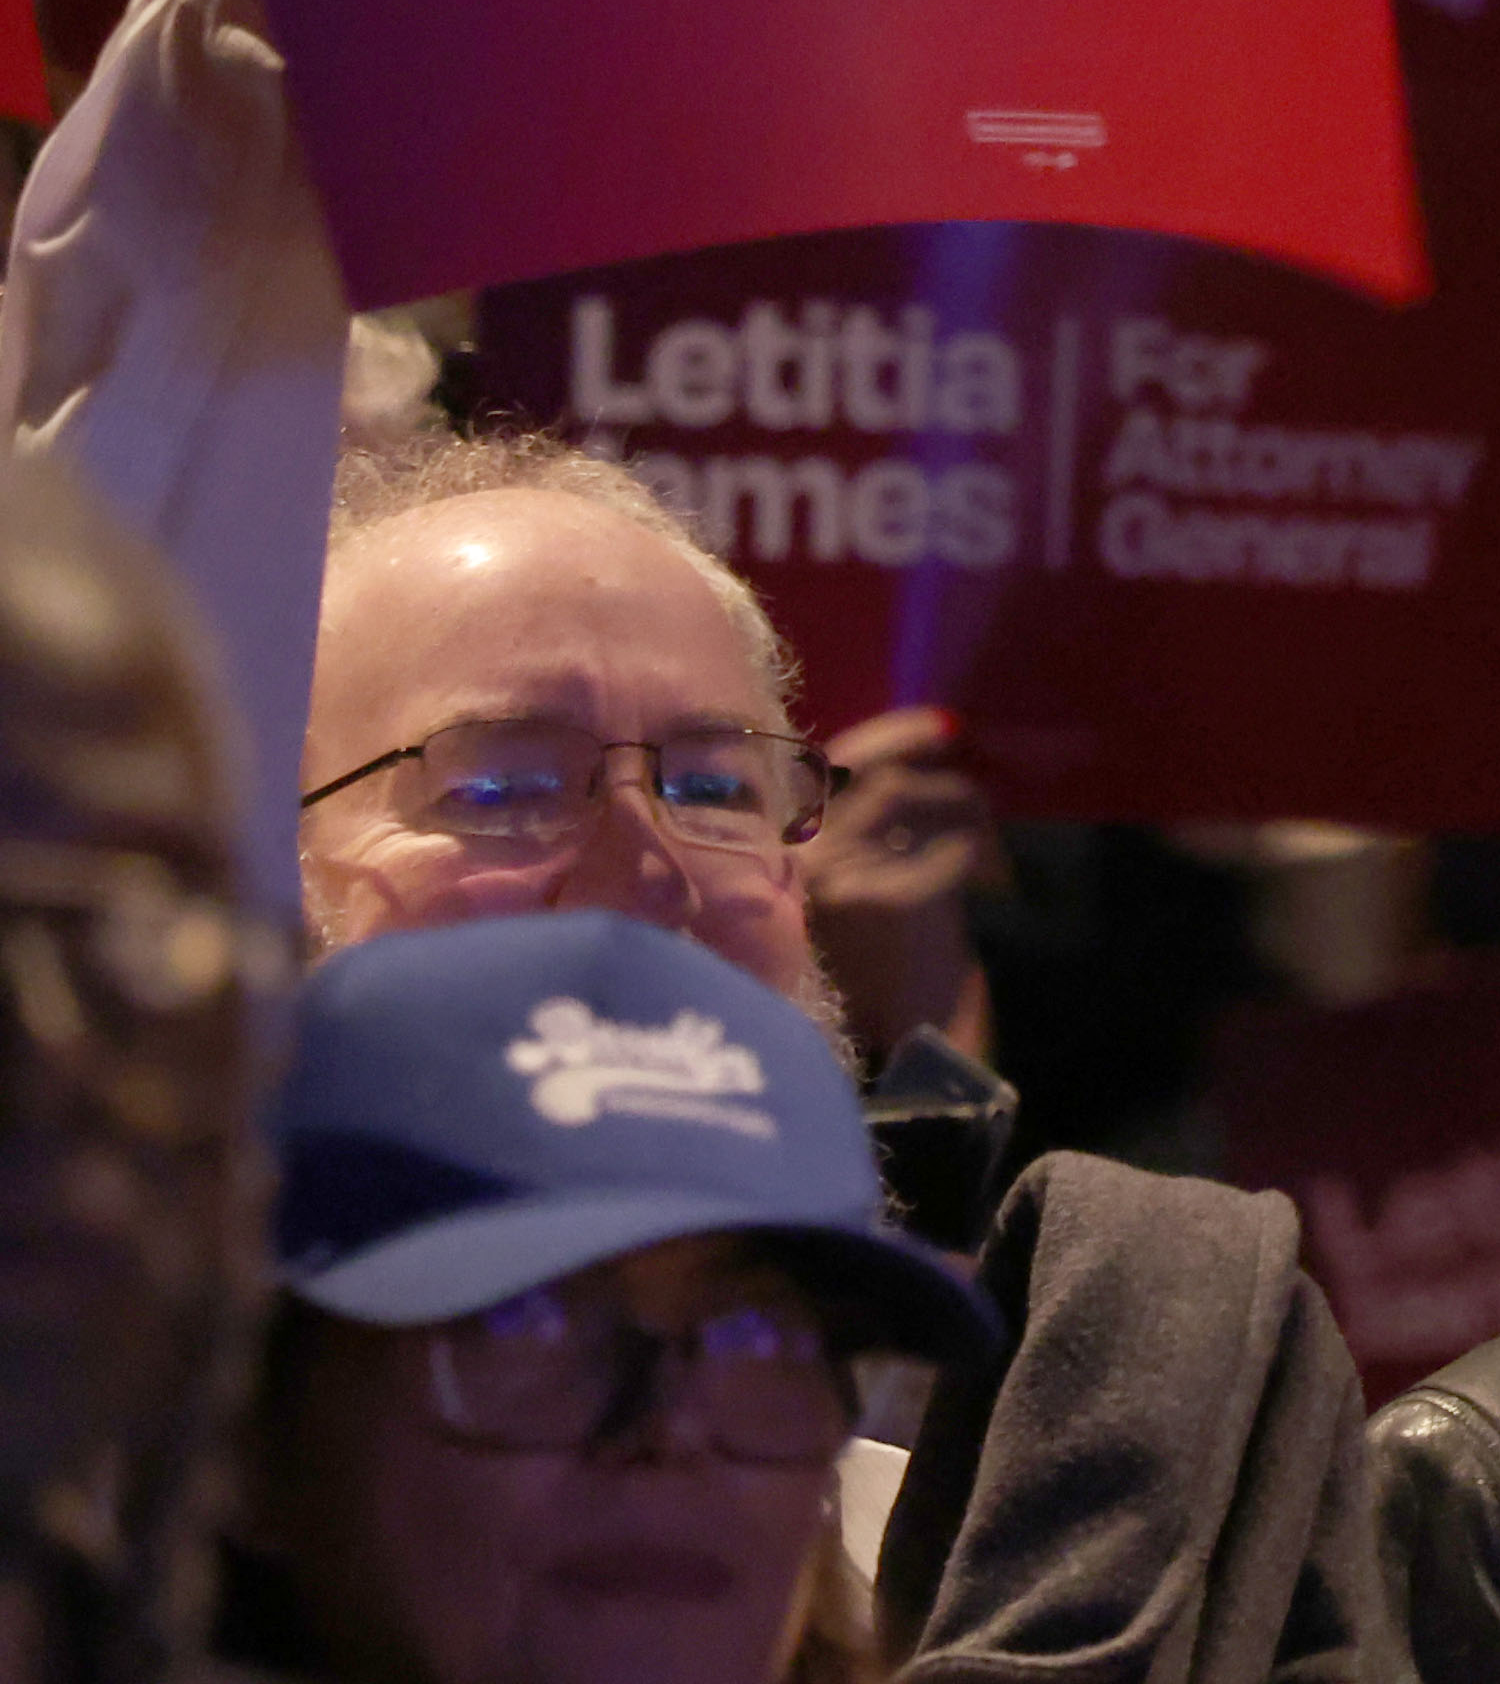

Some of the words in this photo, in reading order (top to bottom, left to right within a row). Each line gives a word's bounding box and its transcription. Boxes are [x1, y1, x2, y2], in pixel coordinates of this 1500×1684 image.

[570, 292, 1024, 433] Letitia
[1108, 316, 1264, 408] For
[630, 448, 1020, 570] ames
